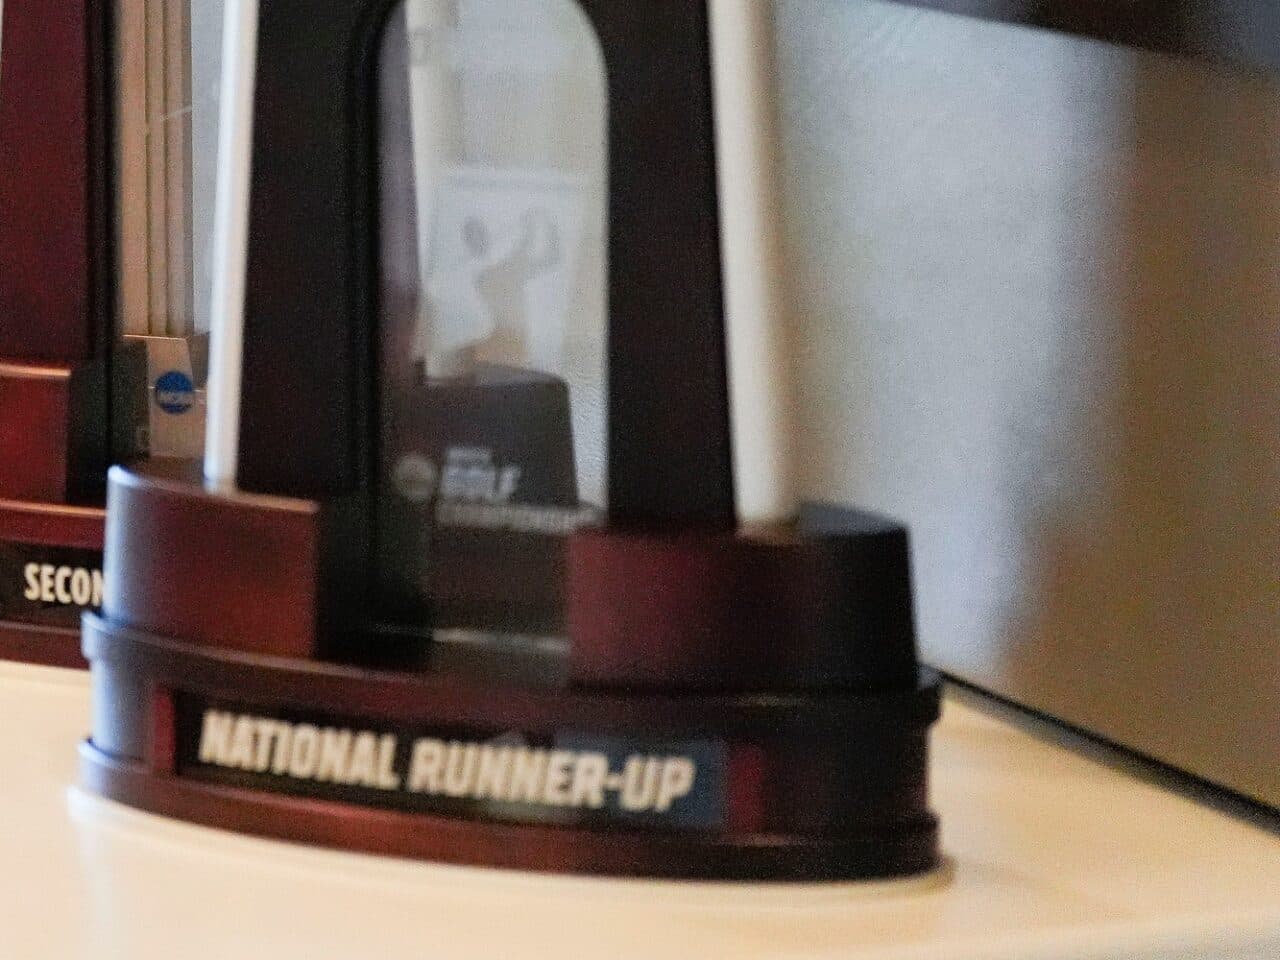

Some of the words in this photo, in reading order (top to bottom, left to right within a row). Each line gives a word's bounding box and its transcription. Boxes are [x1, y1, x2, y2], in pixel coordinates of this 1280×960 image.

[24, 562, 103, 607] SECON
[199, 709, 400, 790] NATIONAL
[407, 739, 697, 813] RUNNER-UP
